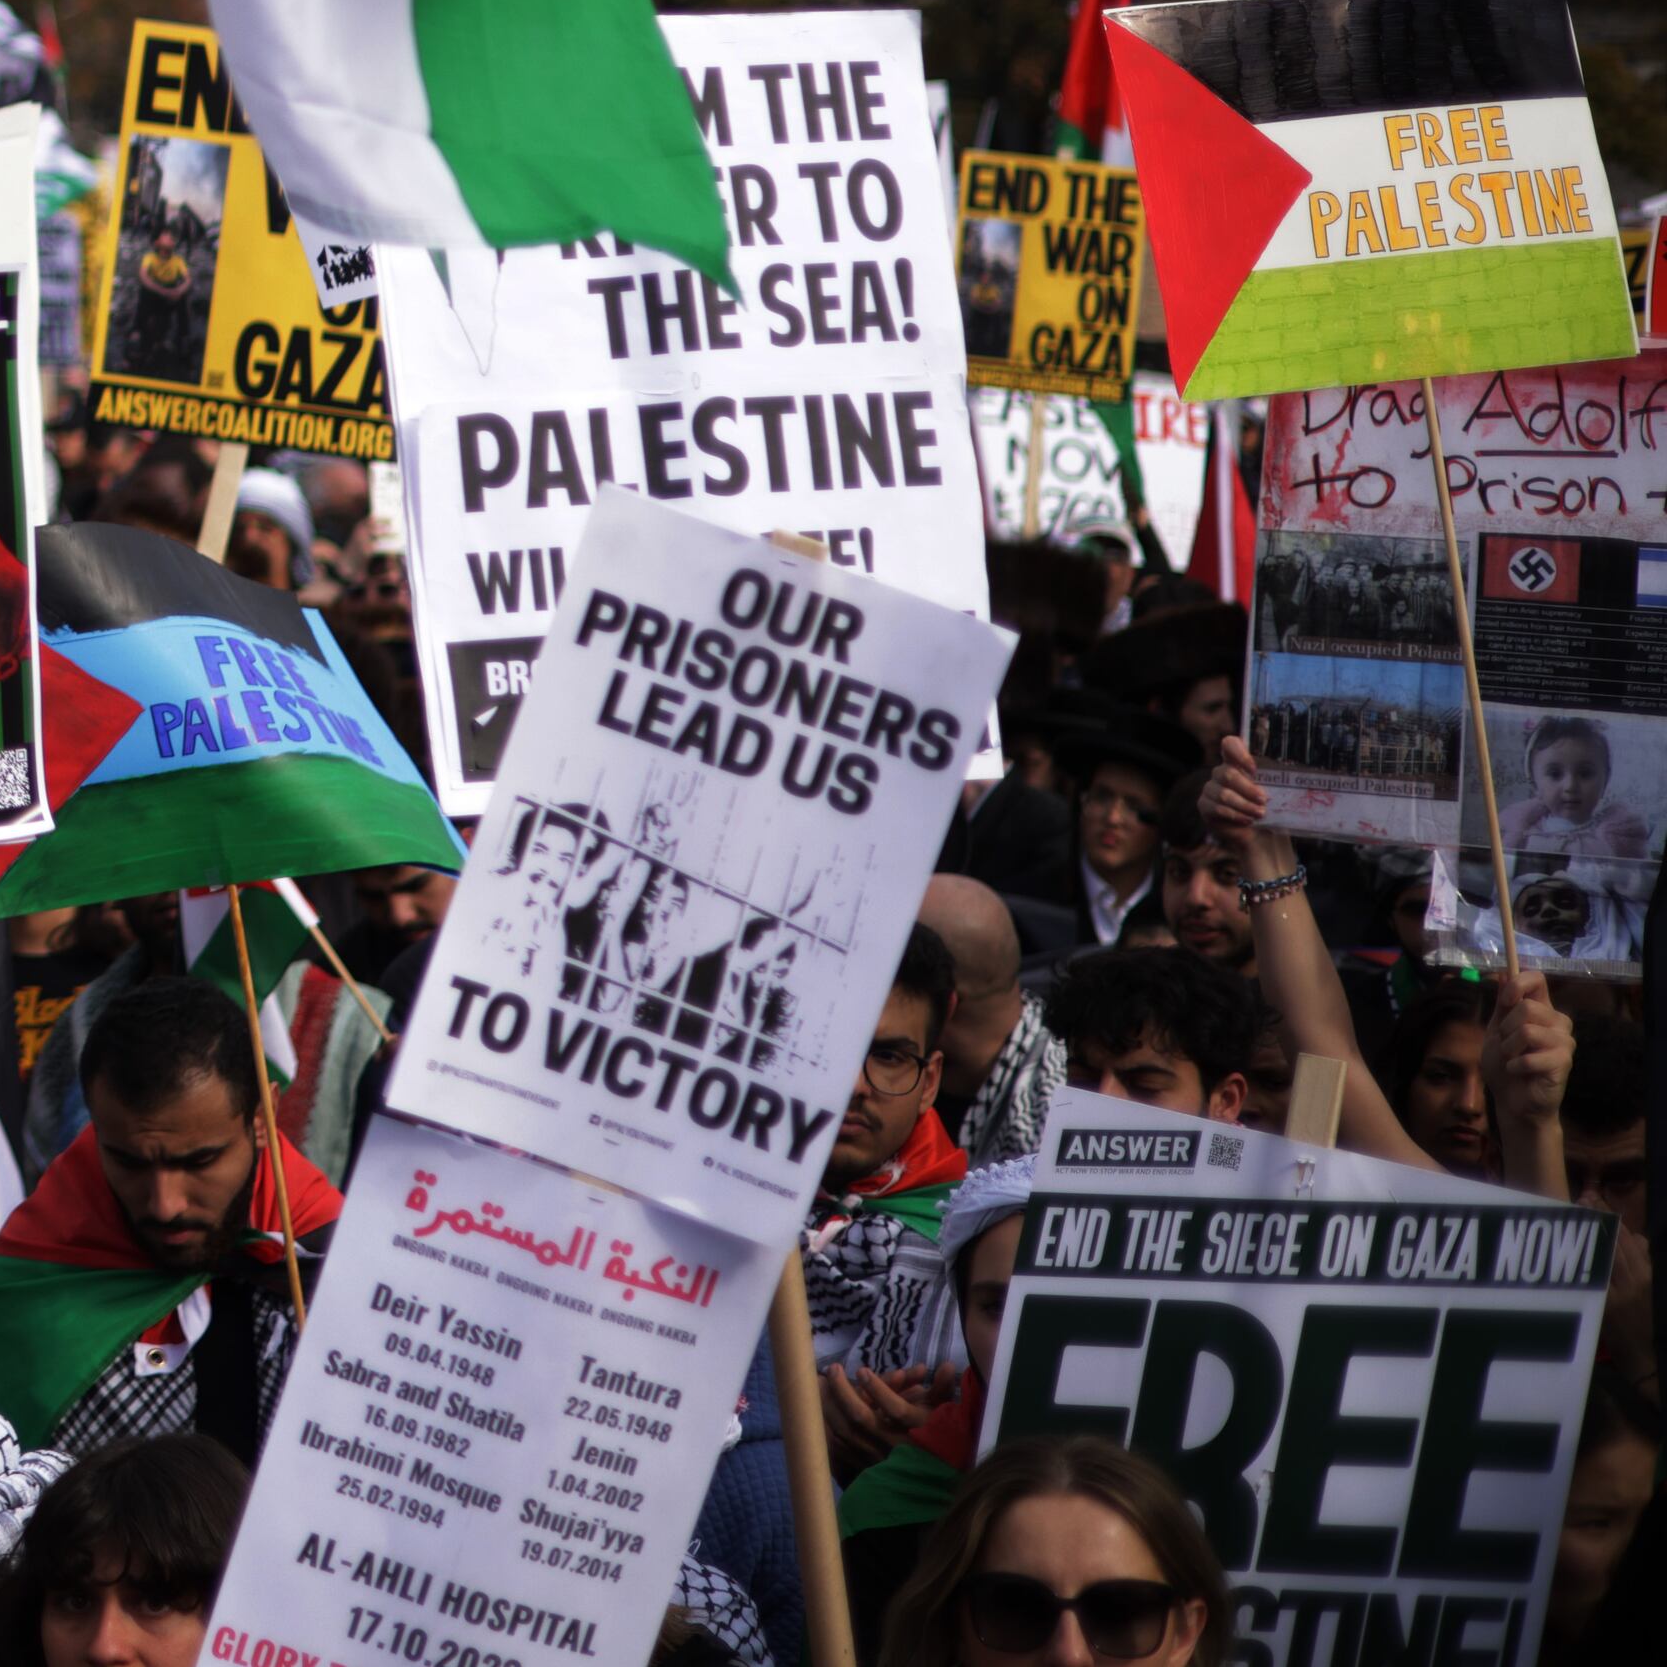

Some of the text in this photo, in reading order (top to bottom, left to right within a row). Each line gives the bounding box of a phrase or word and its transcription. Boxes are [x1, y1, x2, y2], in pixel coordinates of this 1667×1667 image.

[749, 60, 892, 144] THE
[1383, 106, 1512, 170] FREE
[798, 159, 904, 244] TO
[967, 163, 1139, 225] END THE
[1309, 166, 1593, 258] PALESTINE
[1043, 221, 1135, 277] WAR
[587, 258, 922, 360] THE SEA!
[1078, 284, 1130, 326] ON
[1029, 326, 1123, 377] GAZA
[96, 387, 393, 461] ANSWERCOALITION.ORG
[1463, 367, 1667, 453] Adolf
[457, 391, 943, 514] PALESTINE
[1293, 453, 1626, 515] to Prison
[720, 567, 866, 666] OUR
[1290, 636, 1463, 662] Nazi occupied Poland
[194, 635, 319, 700] FREE
[573, 588, 961, 772] PRISONERS
[150, 690, 386, 769] PALESTINE
[597, 669, 773, 778] LEAD
[781, 734, 880, 816] US
[447, 974, 836, 1165] TO VICTORY
[1065, 1136, 1191, 1163] ANSWER
[405, 1169, 719, 1308] النكبة المستمرة
[1034, 1207, 1600, 1283] END THE SIEGE ON GAZA NOW!
[371, 1283, 524, 1361] Deir Yassin
[392, 1234, 697, 1347] ONGOING NAKBA ONGOING NAKBA ONGOING NAKBA
[324, 1350, 526, 1443] Sabra and Shatila
[385, 1333, 496, 1388] 09.04.1948
[576, 1355, 683, 1411] Tantura
[364, 1404, 472, 1460] 16.09.1982
[564, 1396, 673, 1444] 22.05.1948
[572, 1436, 638, 1477] Jenin
[995, 1294, 1582, 1582] FREE
[300, 1420, 502, 1514] Ibrahimi Mosque
[336, 1474, 445, 1529] 25.02.1994
[297, 1533, 598, 1657] AL-AHLI HOSPITAL
[521, 1539, 624, 1583] 19.07.2014
